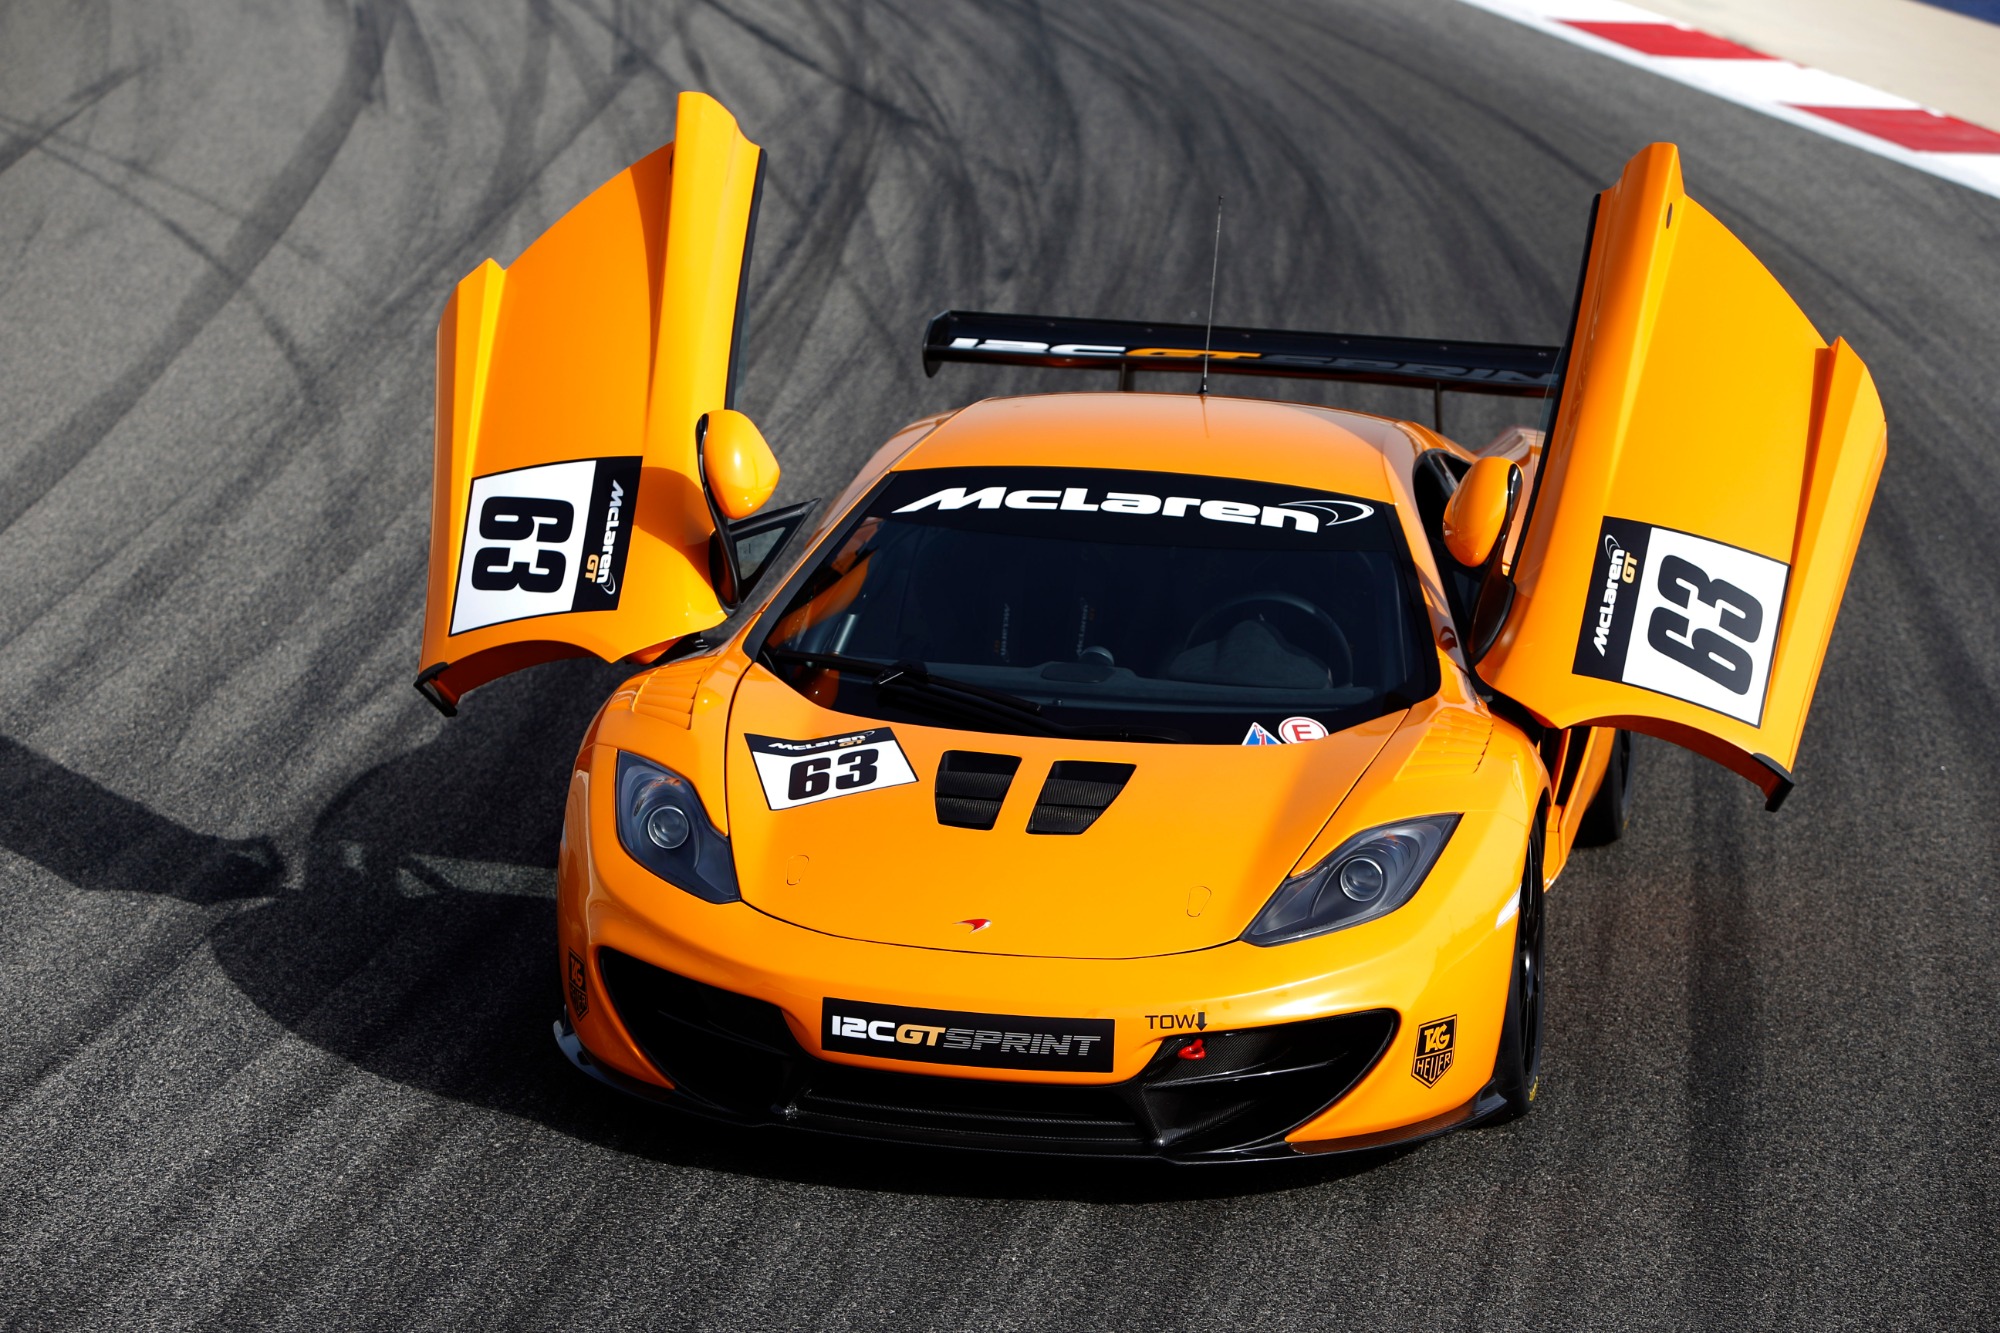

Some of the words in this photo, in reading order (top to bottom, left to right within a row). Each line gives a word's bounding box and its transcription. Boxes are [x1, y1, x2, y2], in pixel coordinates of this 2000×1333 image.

[891, 487, 1319, 533] McLaren
[472, 496, 575, 593] 63
[596, 479, 624, 584] McLaren
[585, 554, 599, 582] GT
[1622, 552, 1638, 584] GT
[1593, 549, 1625, 657] McLaren
[1647, 554, 1763, 695] 63
[768, 735, 866, 750] McLaren
[839, 739, 864, 748] GT
[1291, 724, 1316, 742] E
[788, 749, 879, 800] 63
[1145, 1014, 1197, 1030] TOW
[1424, 1023, 1451, 1053] TAG
[1416, 1052, 1451, 1082] HEUER
